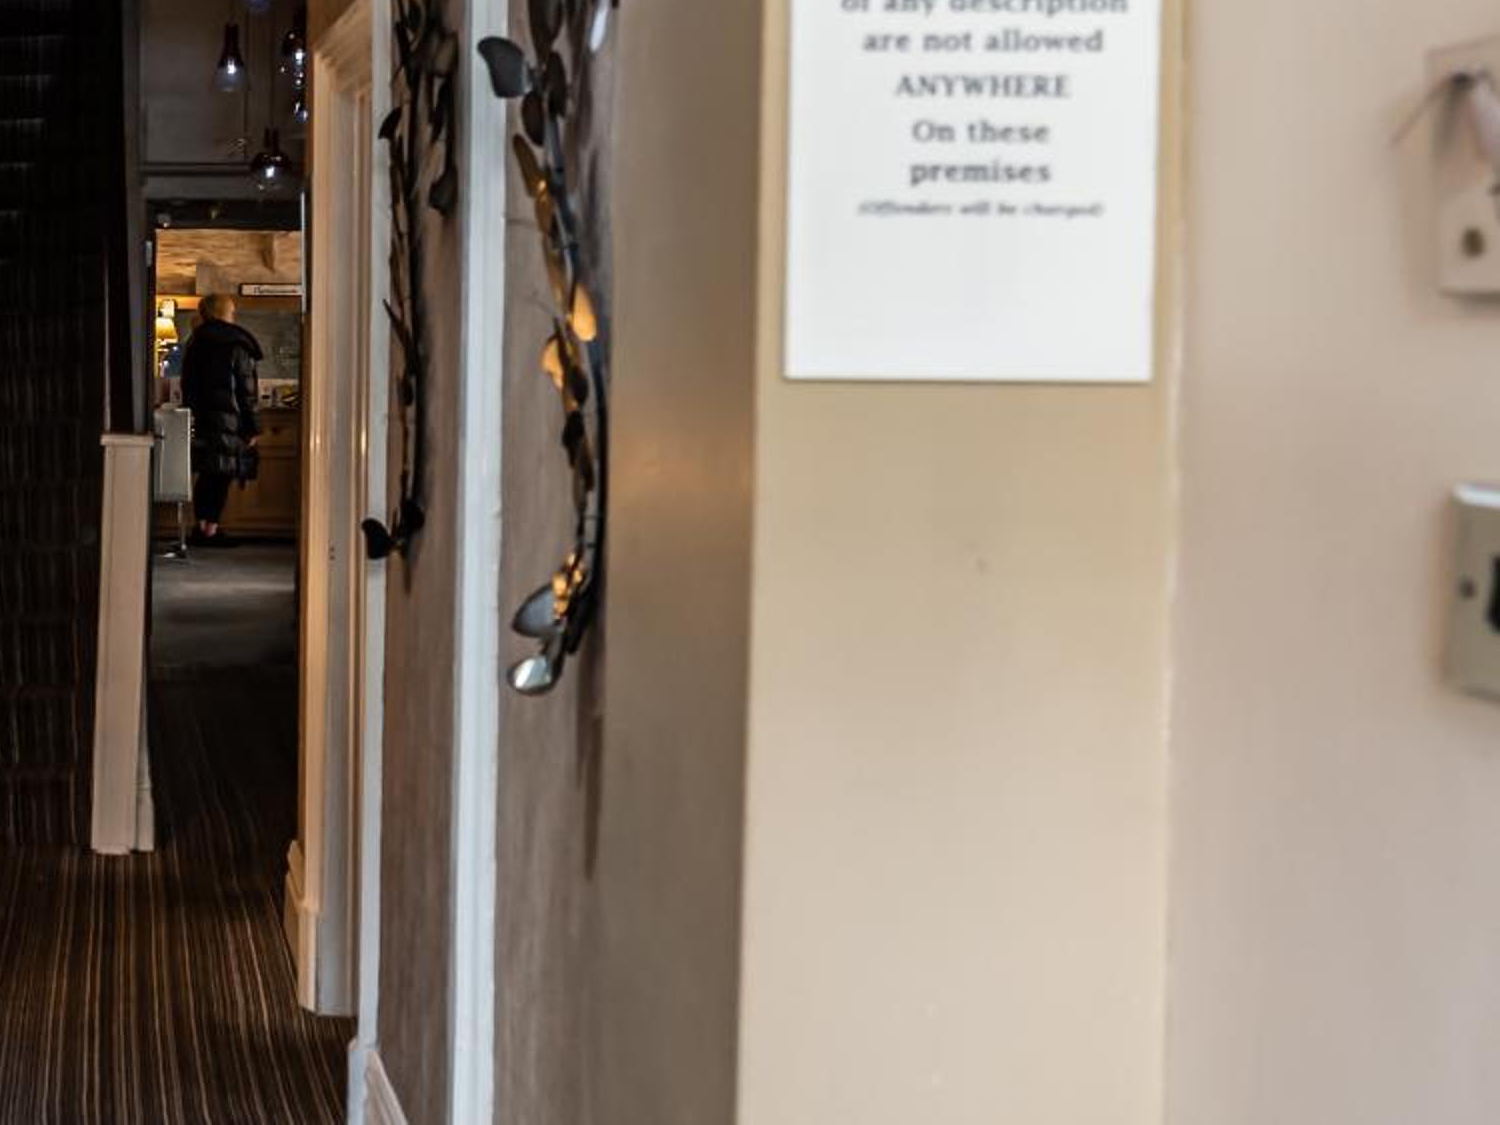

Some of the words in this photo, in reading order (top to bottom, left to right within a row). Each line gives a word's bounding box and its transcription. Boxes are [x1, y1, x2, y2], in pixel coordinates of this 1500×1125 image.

[862, 32, 911, 52] are
[922, 31, 972, 52] not
[984, 28, 1104, 52] allowed
[894, 74, 1069, 98] ANYWHERE
[911, 120, 955, 143] On
[966, 119, 1050, 143] these
[909, 160, 1052, 187] premises
